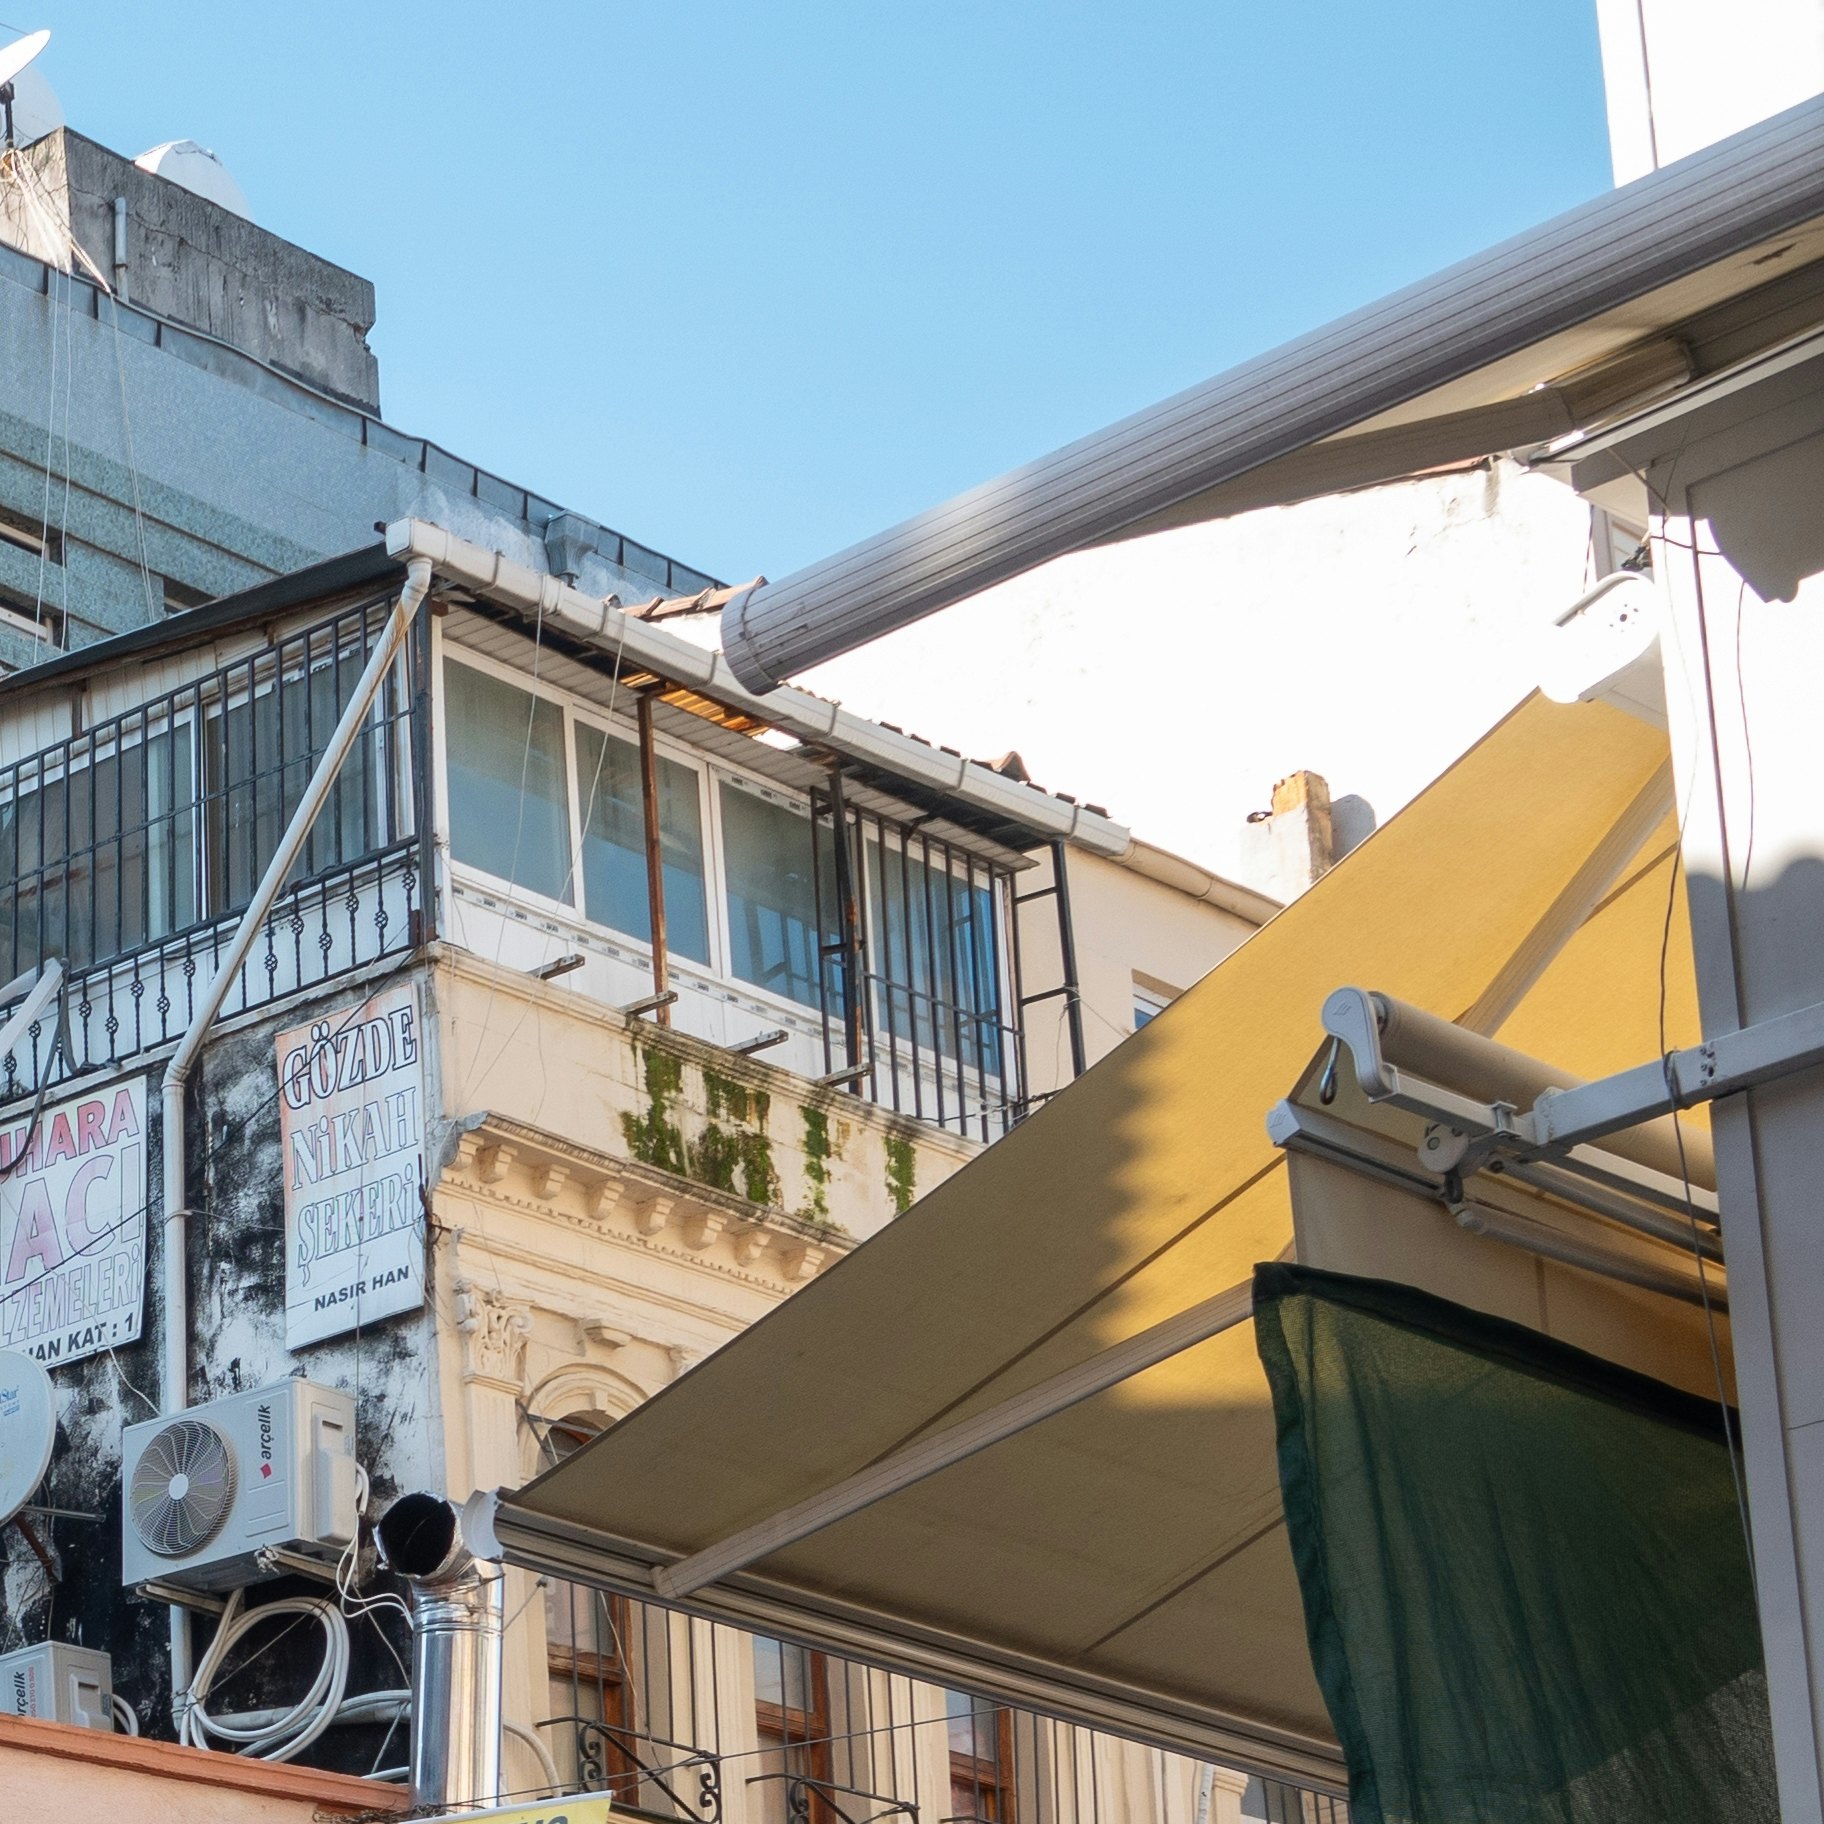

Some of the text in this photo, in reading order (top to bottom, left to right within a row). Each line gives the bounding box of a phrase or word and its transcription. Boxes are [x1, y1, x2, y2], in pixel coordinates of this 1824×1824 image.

[281, 1004, 418, 1111] GÖZDE
[291, 1086, 419, 1191] NİKAH
[297, 1163, 417, 1287] ŞEKERİ
[314, 1265, 410, 1312] NASIR HAN
[68, 1323, 109, 1353] KAT
[123, 1311, 135, 1333] 1
[256, 1404, 274, 1464] arçelik
